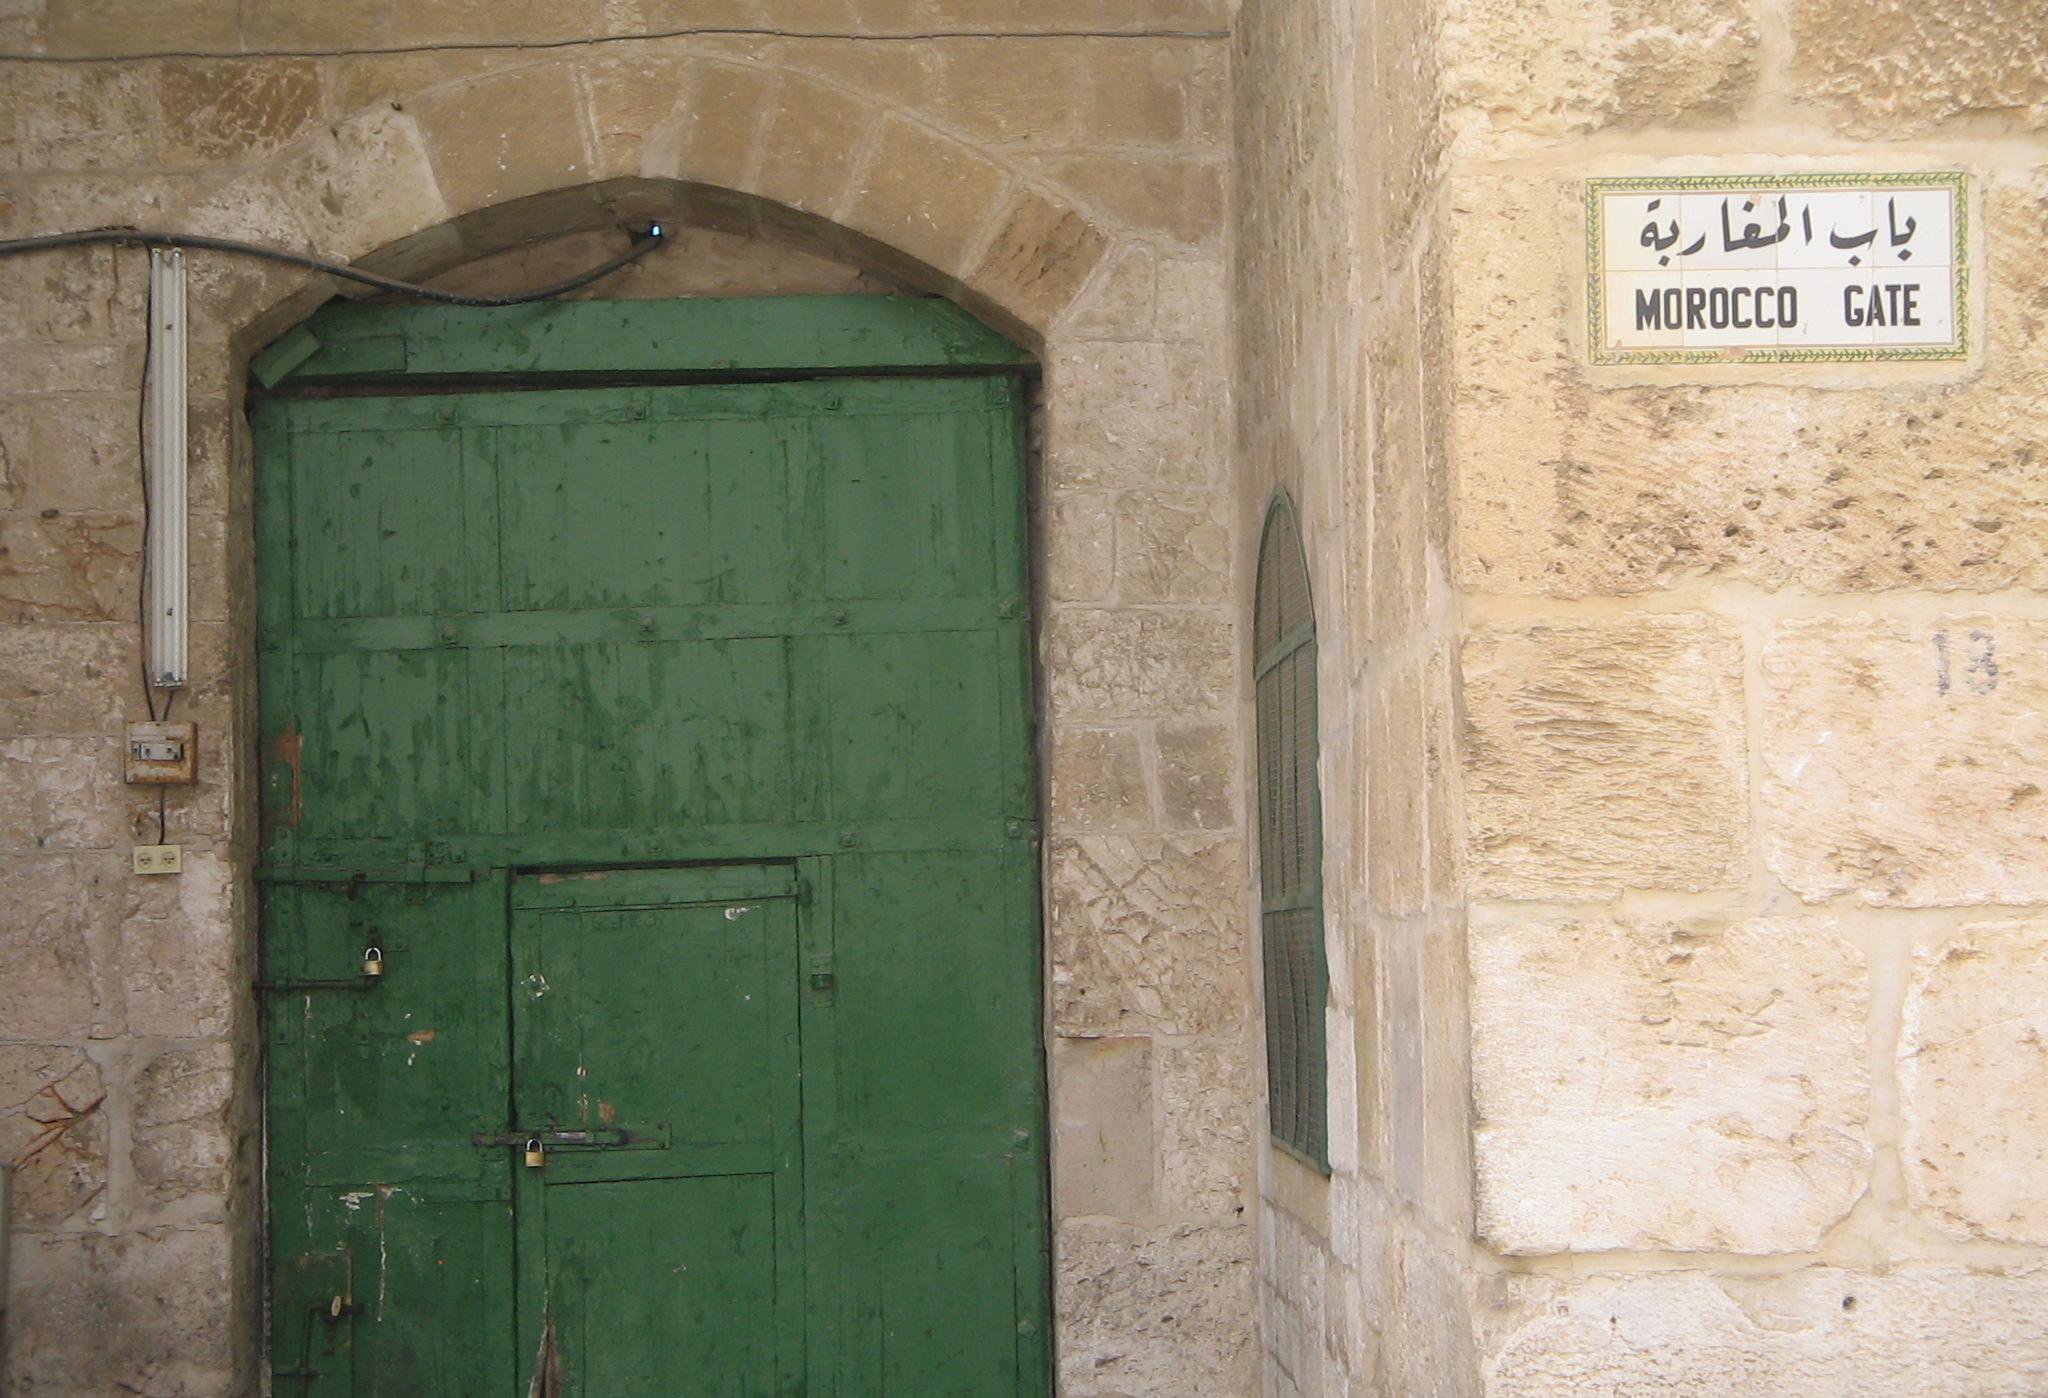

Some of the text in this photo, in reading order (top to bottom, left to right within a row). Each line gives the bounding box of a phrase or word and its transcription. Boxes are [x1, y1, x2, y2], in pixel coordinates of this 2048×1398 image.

[1640, 195, 1917, 267] باب المغاربة
[1636, 283, 1921, 330] MOROCCO GATE
